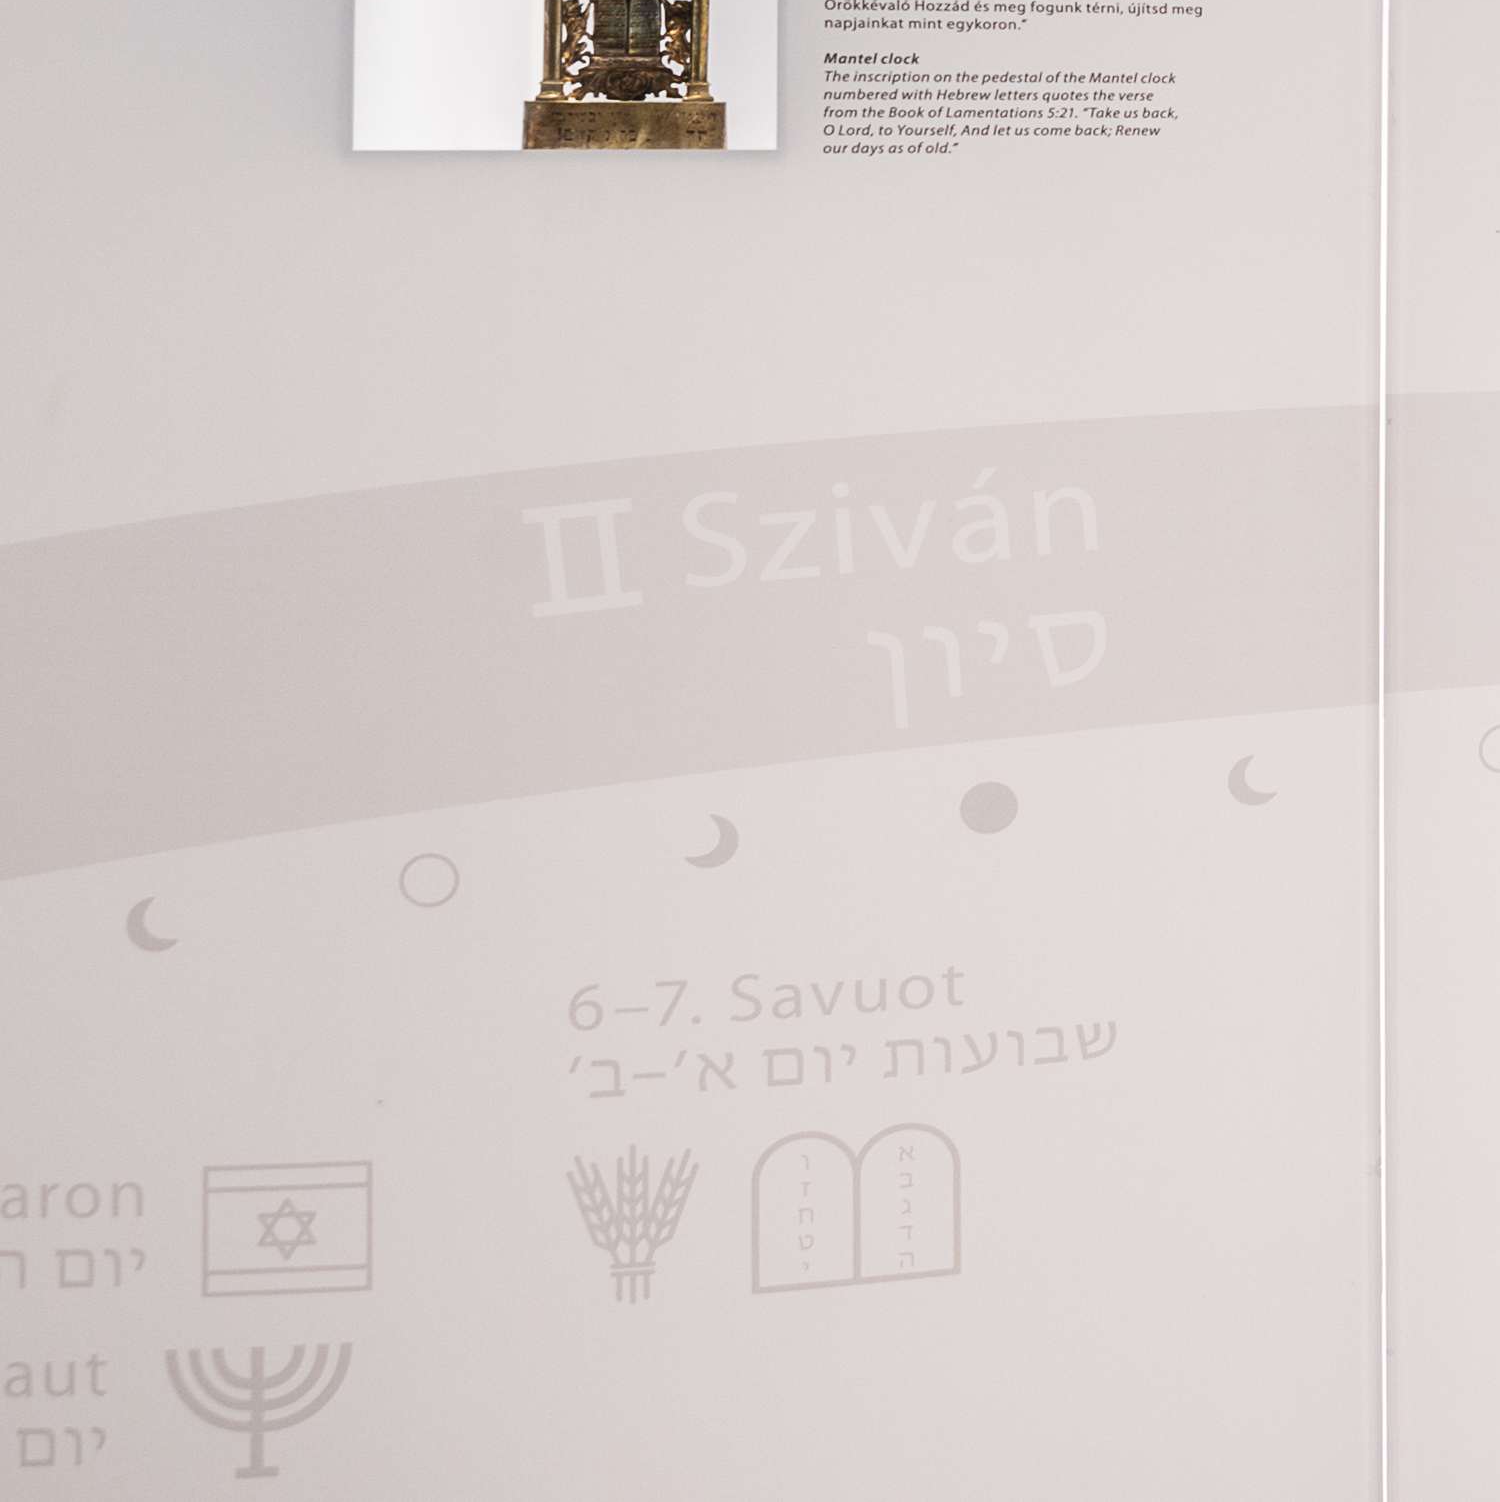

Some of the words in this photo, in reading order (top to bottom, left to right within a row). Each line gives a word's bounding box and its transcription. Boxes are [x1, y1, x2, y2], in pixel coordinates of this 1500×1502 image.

[915, 0, 969, 11] Hozzád
[975, 2, 989, 11] és
[994, 4, 1026, 15] meg
[1030, 2, 1081, 15] fogunk
[1087, 3, 1123, 15] térni,
[1129, 3, 1167, 16] újítsd
[1172, 7, 1203, 17] meg
[825, 19, 904, 31] napjainkat
[909, 20, 942, 29] mint
[824, 53, 878, 64] Mantel
[881, 53, 919, 64] clock
[825, 71, 849, 82] The
[854, 71, 929, 84] inscription
[934, 74, 952, 82] on
[956, 72, 978, 82] the
[982, 71, 1041, 85] pedestal
[1046, 72, 1062, 83] of
[1064, 73, 1086, 83] the
[1089, 72, 1138, 83] Mantel
[1141, 73, 1176, 84] clock
[824, 89, 897, 100] numbered
[902, 89, 932, 100] with
[937, 89, 991, 100] Hebrew
[994, 89, 1038, 100] letters
[1042, 91, 1089, 102] quotes
[1094, 90, 1115, 101] the
[1119, 93, 1154, 101] verse
[824, 107, 857, 118] from
[862, 107, 884, 118] the
[889, 107, 924, 118] Book
[928, 106, 943, 118] of
[946, 107, 1043, 118] Lamentations
[1048, 108, 1078, 118] 5:21.
[1124, 110, 1138, 118] us
[1142, 108, 1178, 120] back,
[824, 125, 834, 135] O
[839, 125, 874, 137] Lord,
[879, 127, 892, 135] to
[898, 125, 957, 137] Yourself,
[961, 125, 989, 135] And
[994, 125, 1011, 135] let
[1015, 127, 1029, 136] us
[1034, 127, 1071, 136] come
[1075, 125, 1112, 137] back;
[1116, 125, 1160, 136] Renew
[824, 145, 847, 153] our
[851, 142, 884, 156] days
[889, 145, 903, 153] as
[908, 142, 923, 153] of
[680, 467, 1104, 589] Sziván
[866, 609, 1109, 731] סיון
[729, 964, 967, 1024] Savuot
[882, 1017, 1119, 1080] שבועות
[763, 1042, 859, 1088] יום
[55, 1247, 146, 1289] יום
[17, 1426, 108, 1468] יום
